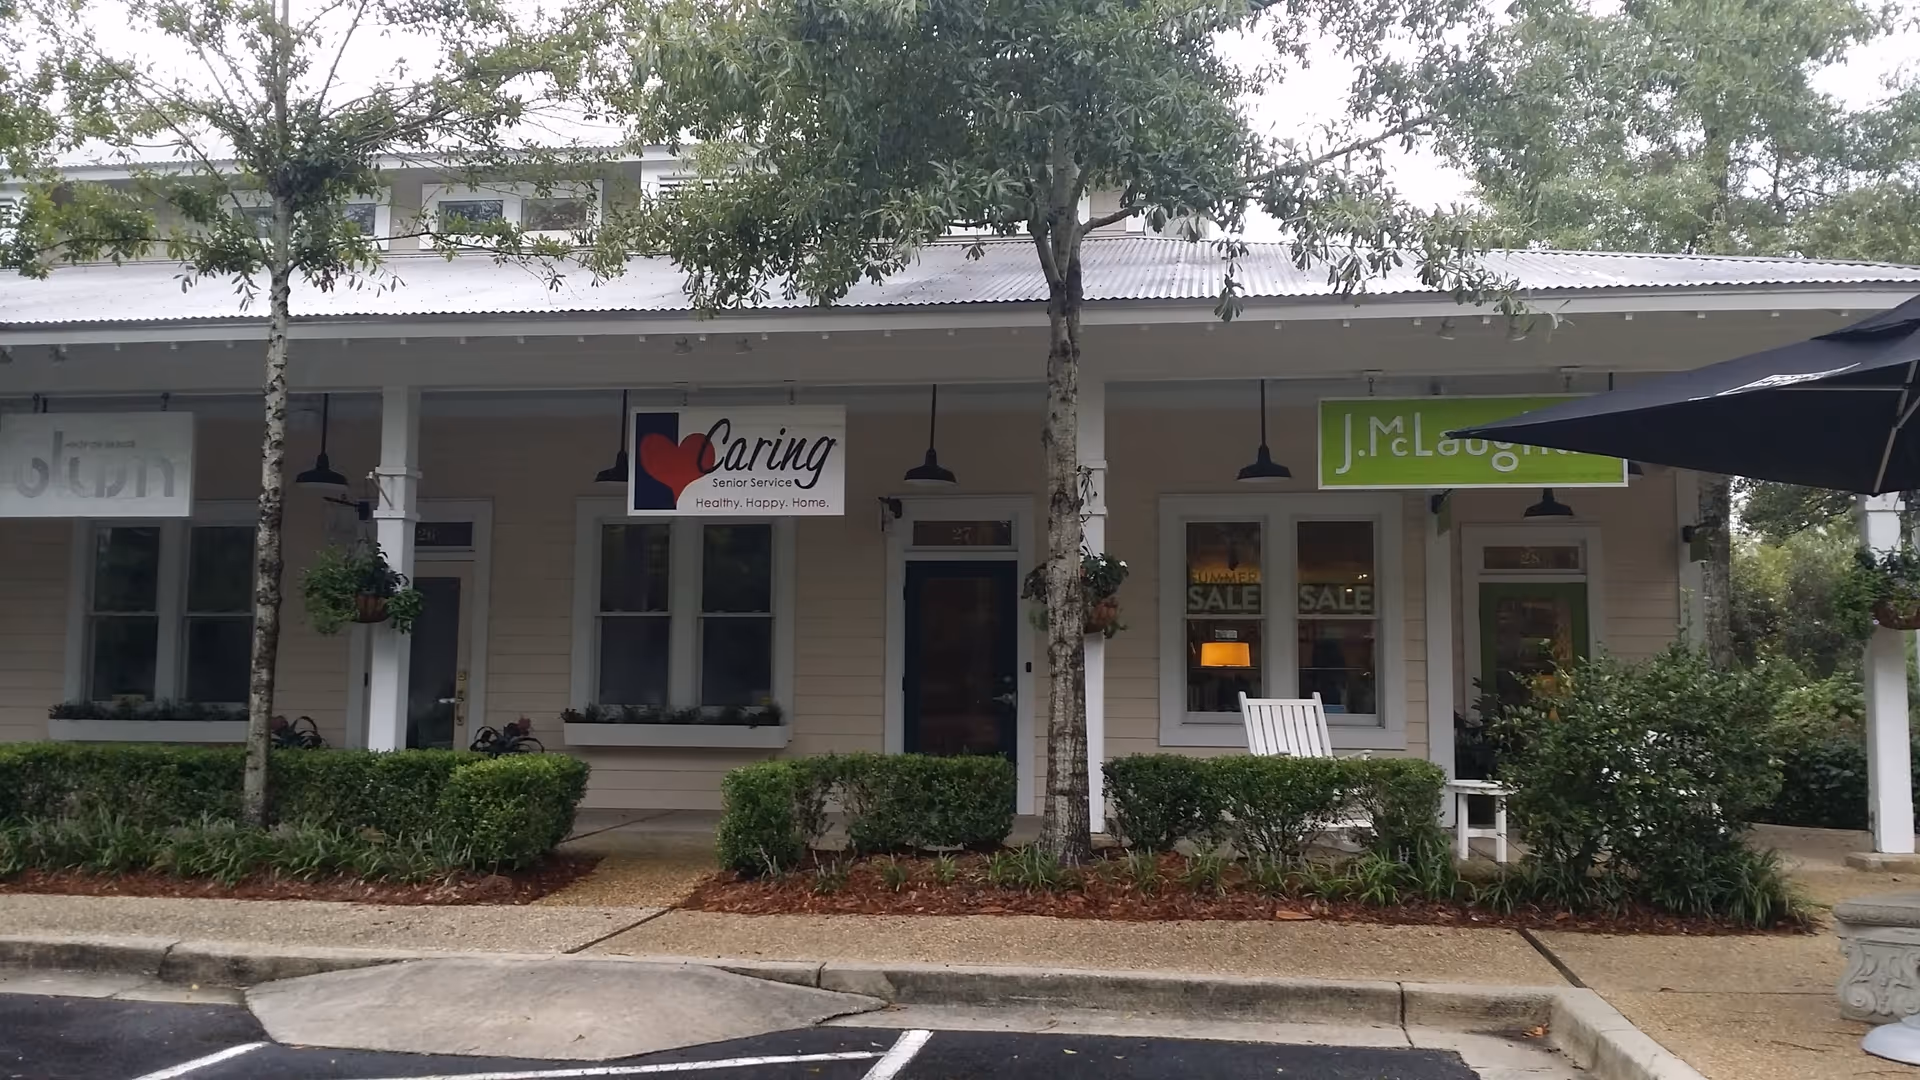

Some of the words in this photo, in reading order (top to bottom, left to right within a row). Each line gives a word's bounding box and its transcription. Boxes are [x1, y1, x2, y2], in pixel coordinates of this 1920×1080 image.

[697, 418, 837, 490] Caring
[712, 478, 748, 488] Senior
[750, 478, 792, 488] Service
[696, 498, 742, 509] Healthy.
[746, 498, 788, 509] Happy.
[792, 498, 830, 508] Home.
[1188, 585, 1258, 611] SALE
[1299, 585, 1371, 611] SALE
